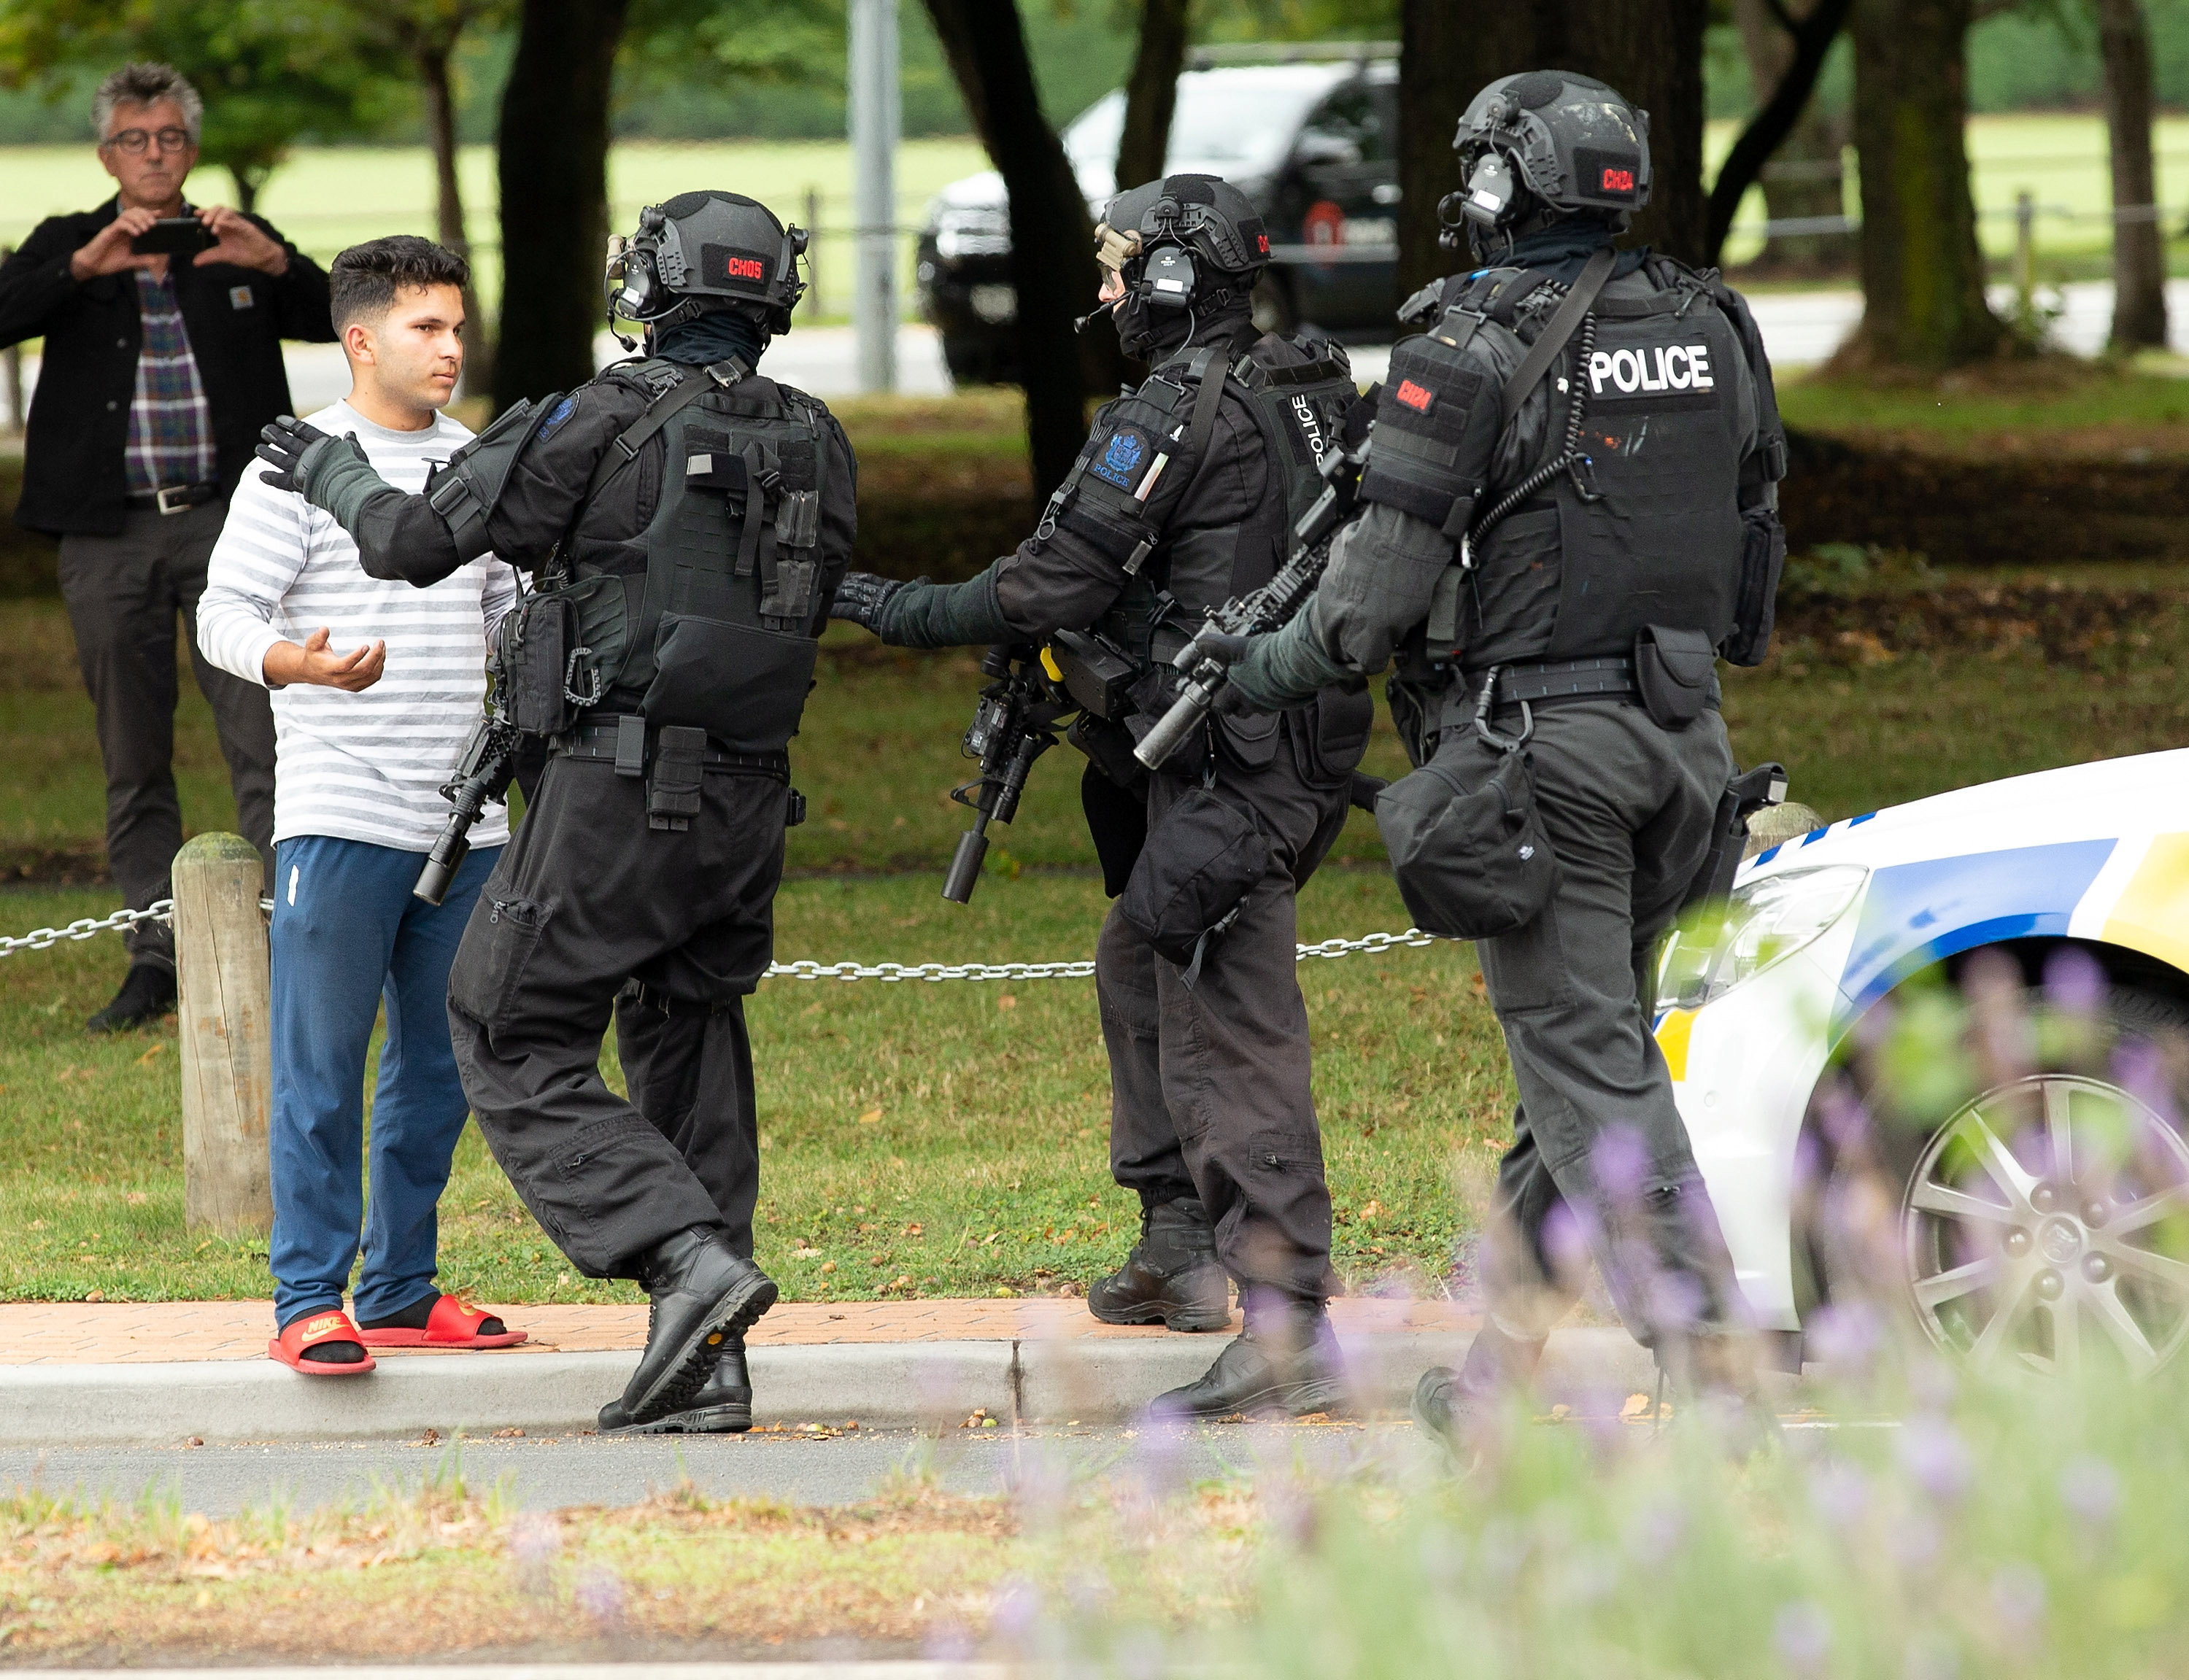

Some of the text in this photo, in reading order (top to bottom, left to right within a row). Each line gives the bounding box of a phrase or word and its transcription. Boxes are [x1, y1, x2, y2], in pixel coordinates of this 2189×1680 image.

[729, 258, 763, 279] CH05
[1589, 345, 1714, 393] POLICE
[1292, 395, 1324, 467] POLICE
[1094, 463, 1130, 487] POLICE
[307, 1317, 341, 1333] NIKE
